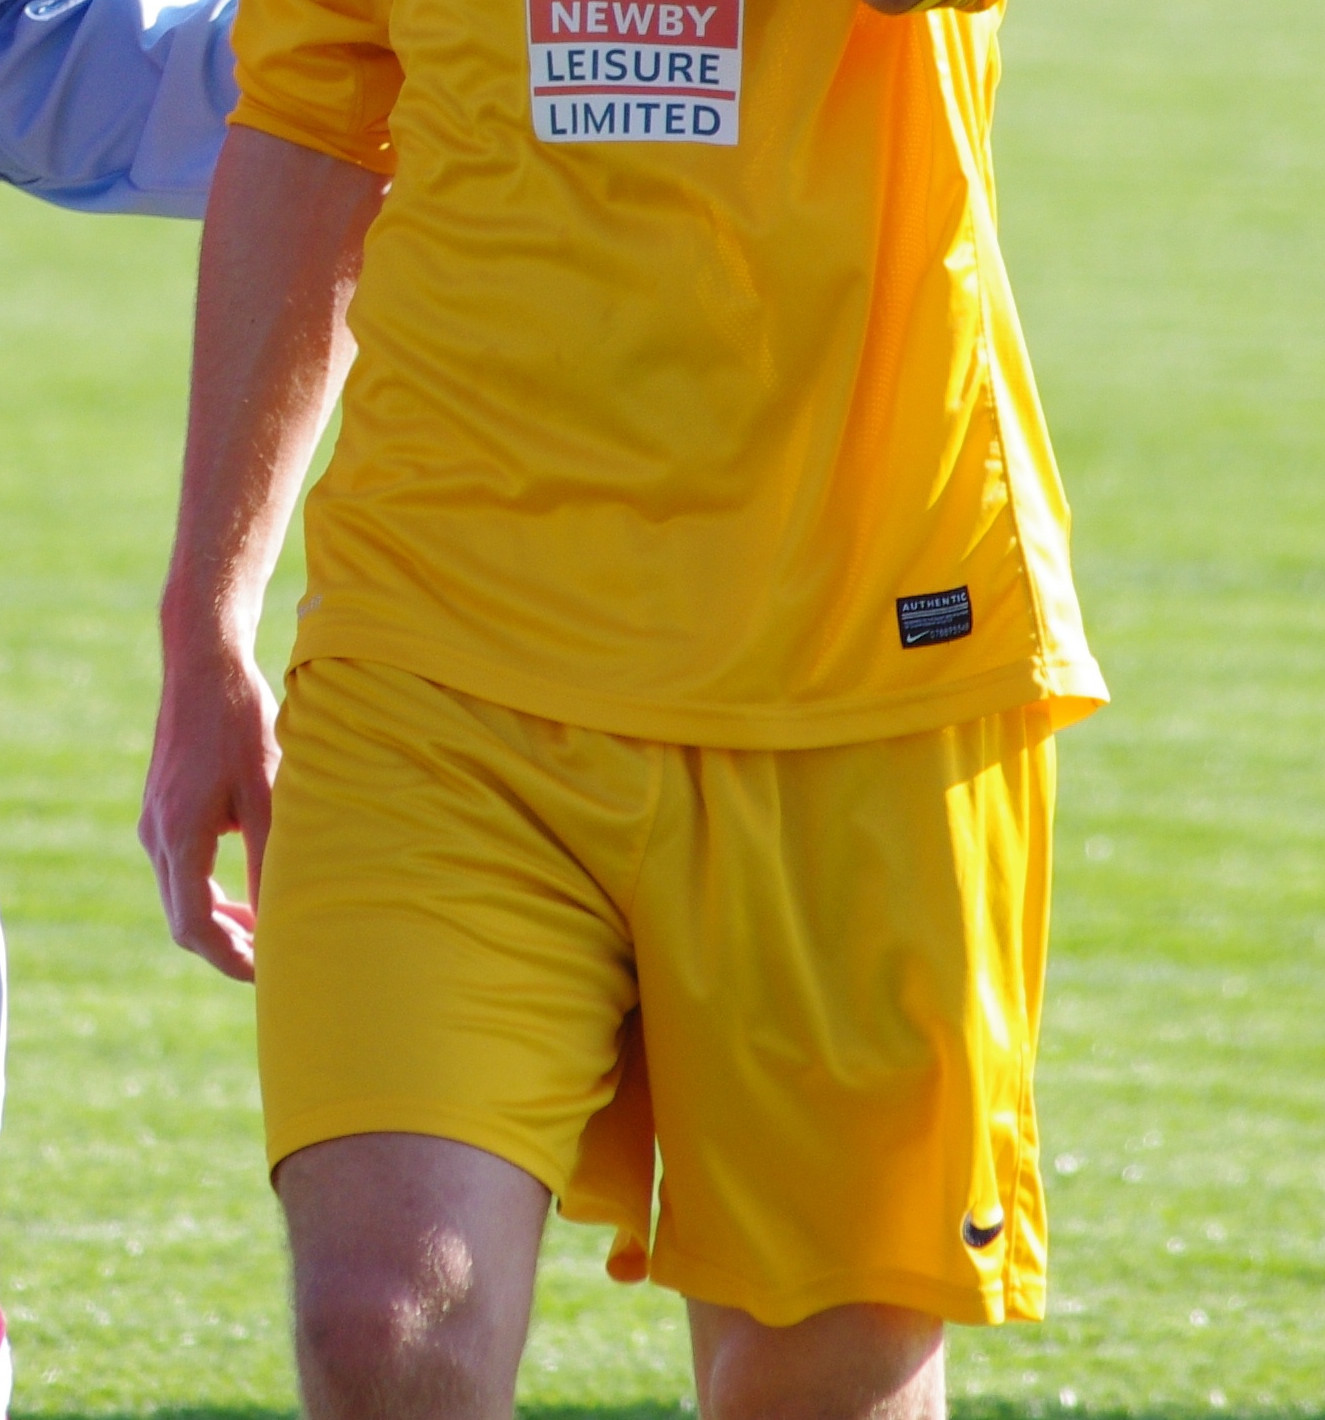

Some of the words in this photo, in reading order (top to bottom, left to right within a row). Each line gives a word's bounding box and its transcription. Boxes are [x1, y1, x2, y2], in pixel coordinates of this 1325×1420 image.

[550, 0, 717, 38] NEWBY
[546, 48, 721, 85] LEISURE
[549, 102, 722, 137] LIMITED
[903, 592, 967, 611] AUTHENTIC
